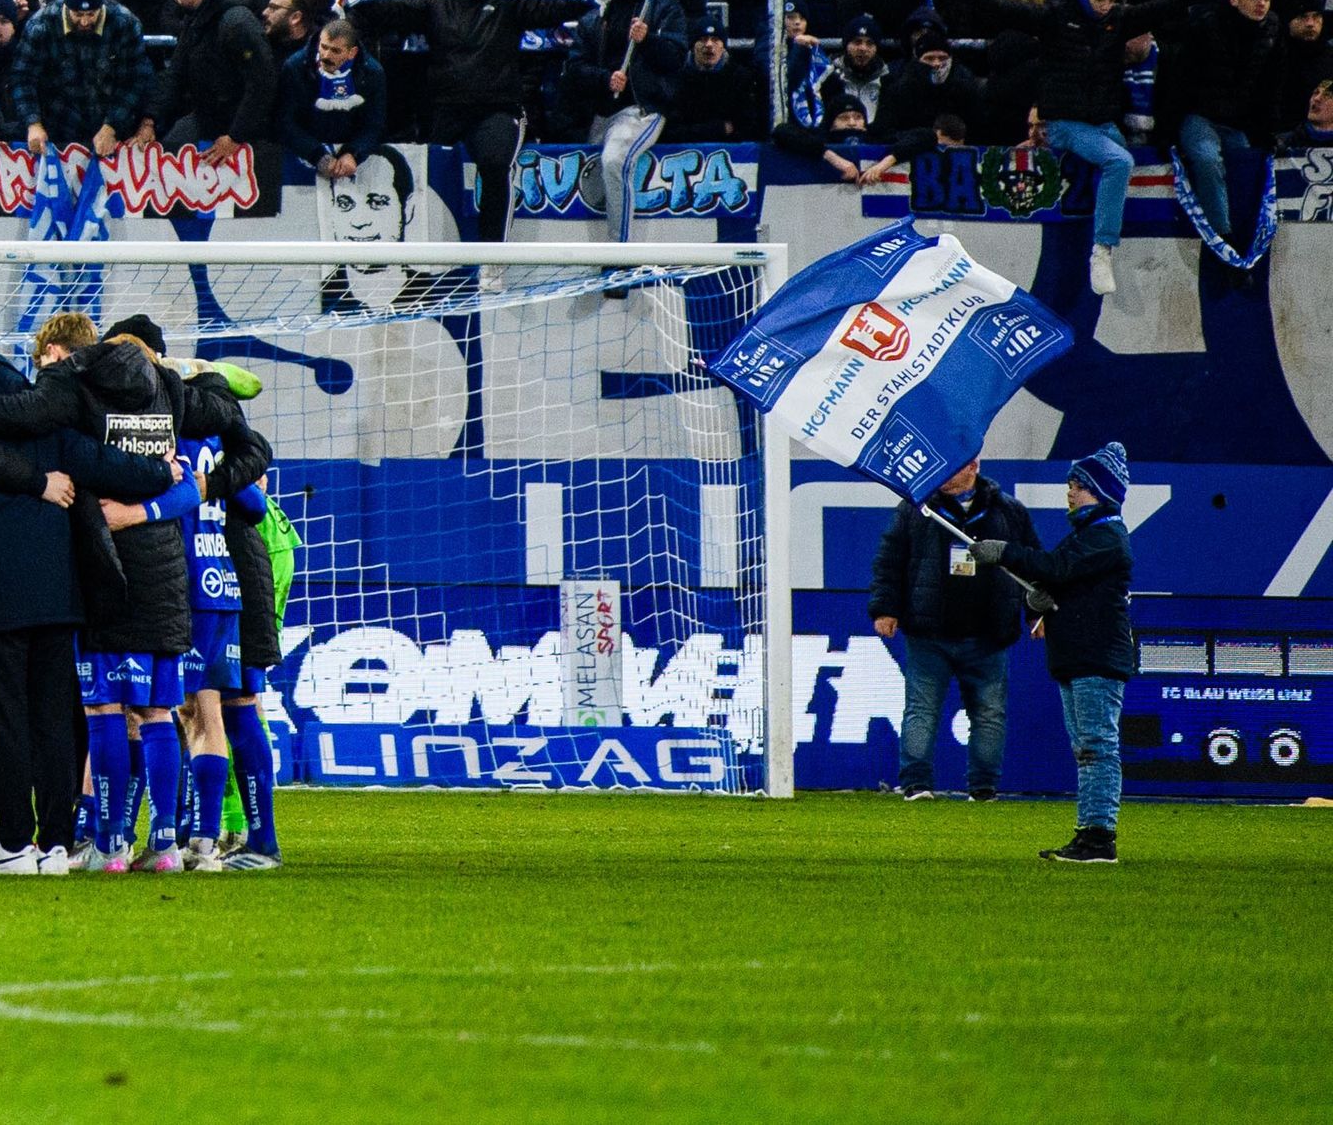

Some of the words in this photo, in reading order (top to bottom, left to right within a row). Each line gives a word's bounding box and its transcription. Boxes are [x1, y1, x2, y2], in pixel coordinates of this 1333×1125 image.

[850, 407, 882, 442] DER
[876, 294, 987, 407] STAHLSTADTKLUB
[574, 589, 597, 708] MELASAN
[596, 588, 616, 658] SPORT
[317, 731, 550, 781] LINZ
[578, 737, 726, 785] AG
[99, 776, 110, 820] LIWEST
